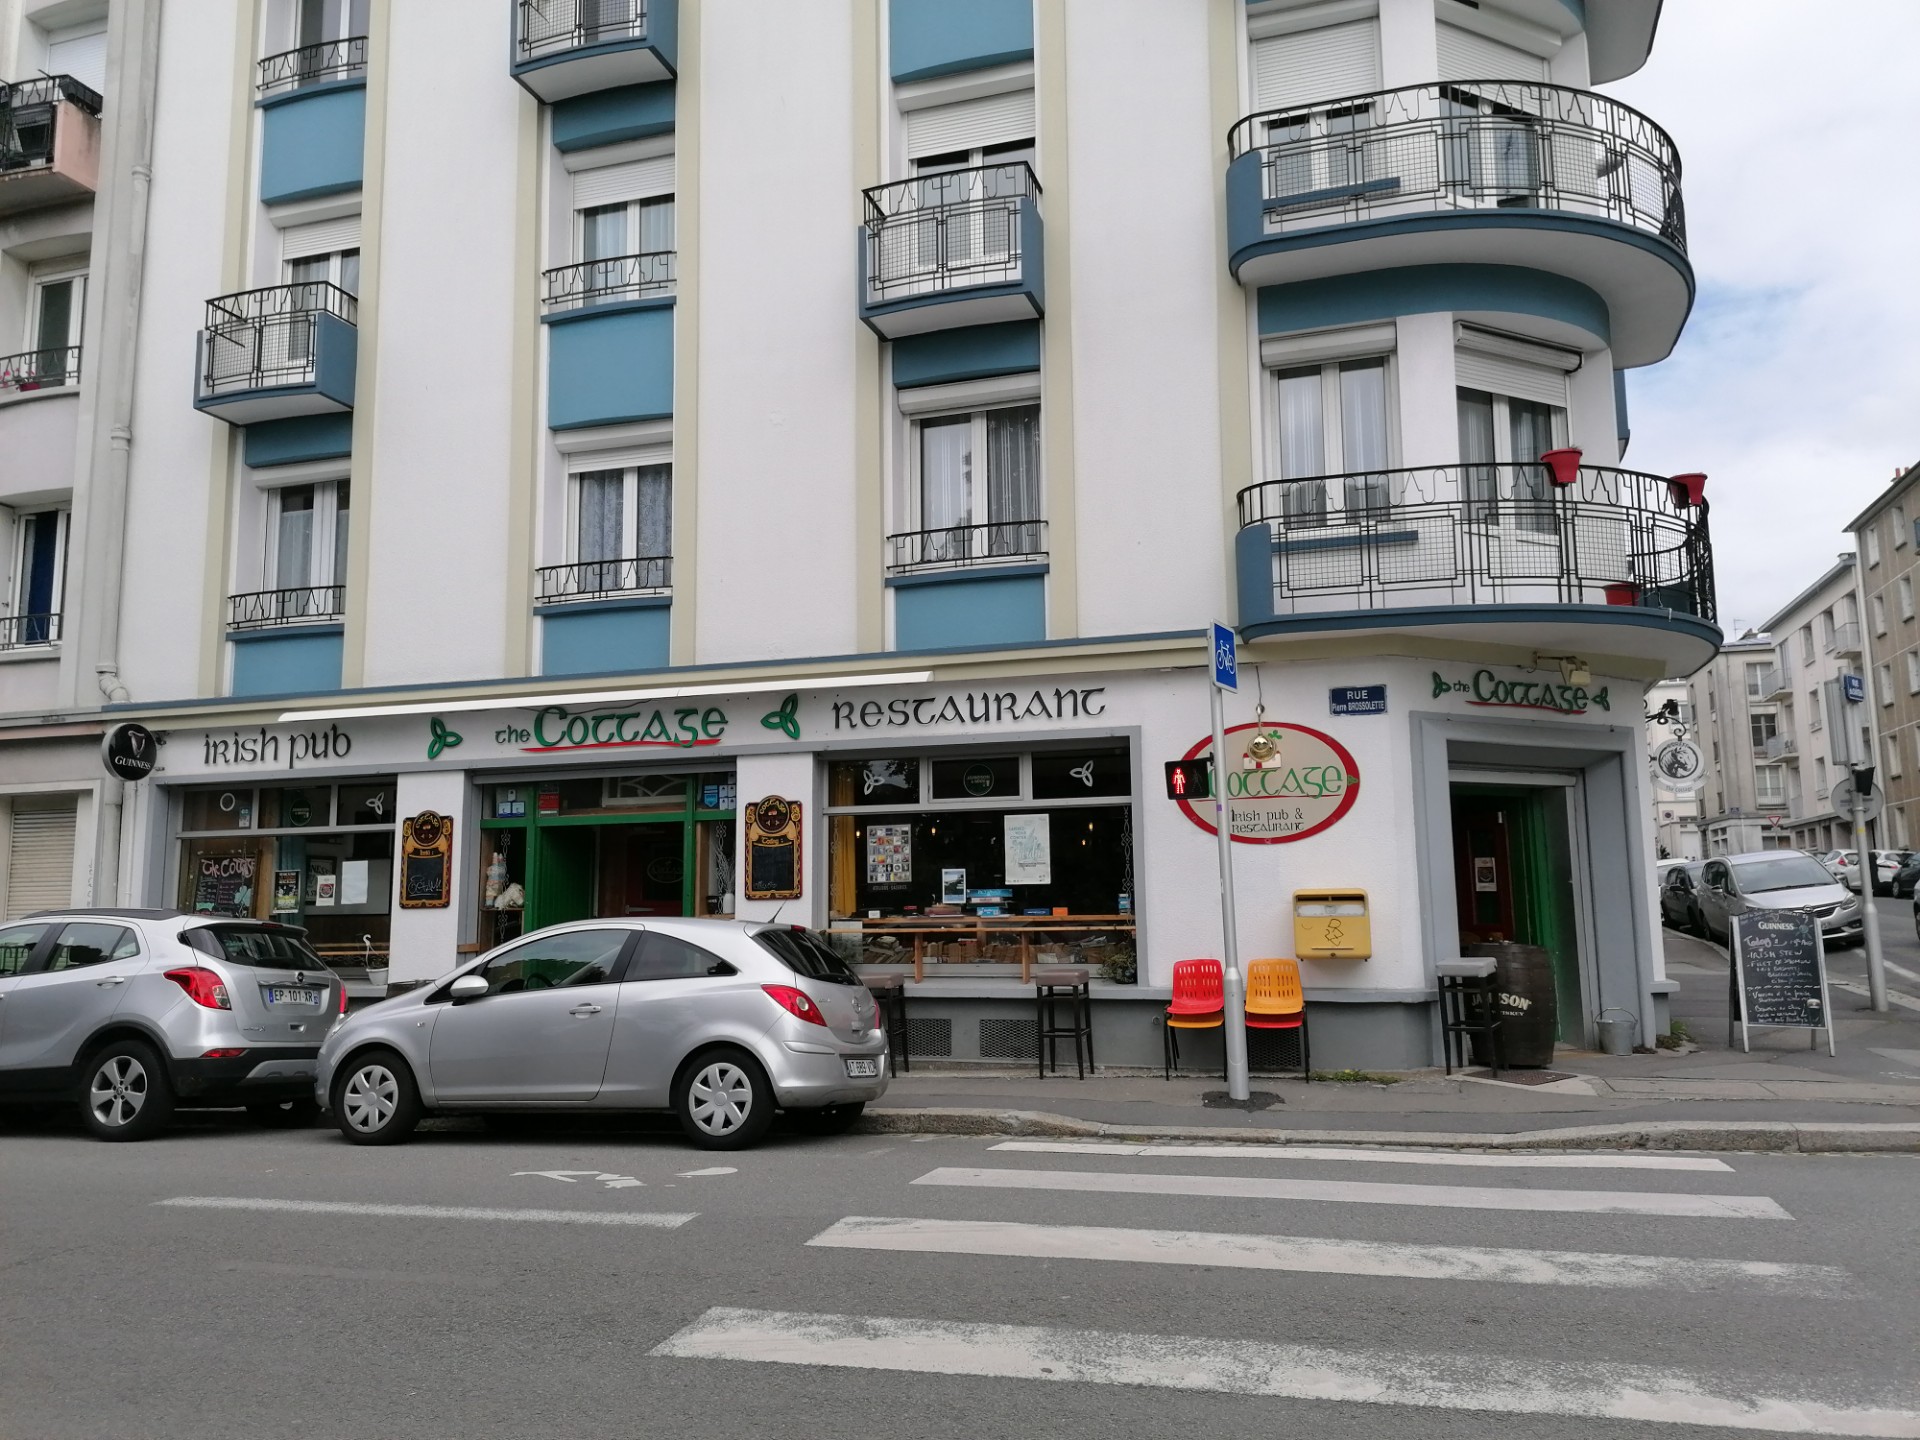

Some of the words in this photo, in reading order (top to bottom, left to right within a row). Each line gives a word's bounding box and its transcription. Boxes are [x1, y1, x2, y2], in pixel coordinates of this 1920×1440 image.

[1453, 680, 1470, 693] the
[1346, 690, 1369, 700] RUE
[1332, 702, 1347, 711] Pierre
[1347, 700, 1385, 711] BROSSOLETTE
[494, 724, 531, 744] the
[287, 723, 351, 769] pub
[114, 755, 152, 770] GUINNESS
[1231, 806, 1261, 822] Irish
[1266, 808, 1289, 826] pub
[1294, 807, 1304, 820] &
[1758, 921, 1795, 931] GUINNESS
[1472, 991, 1530, 1011] JASON
